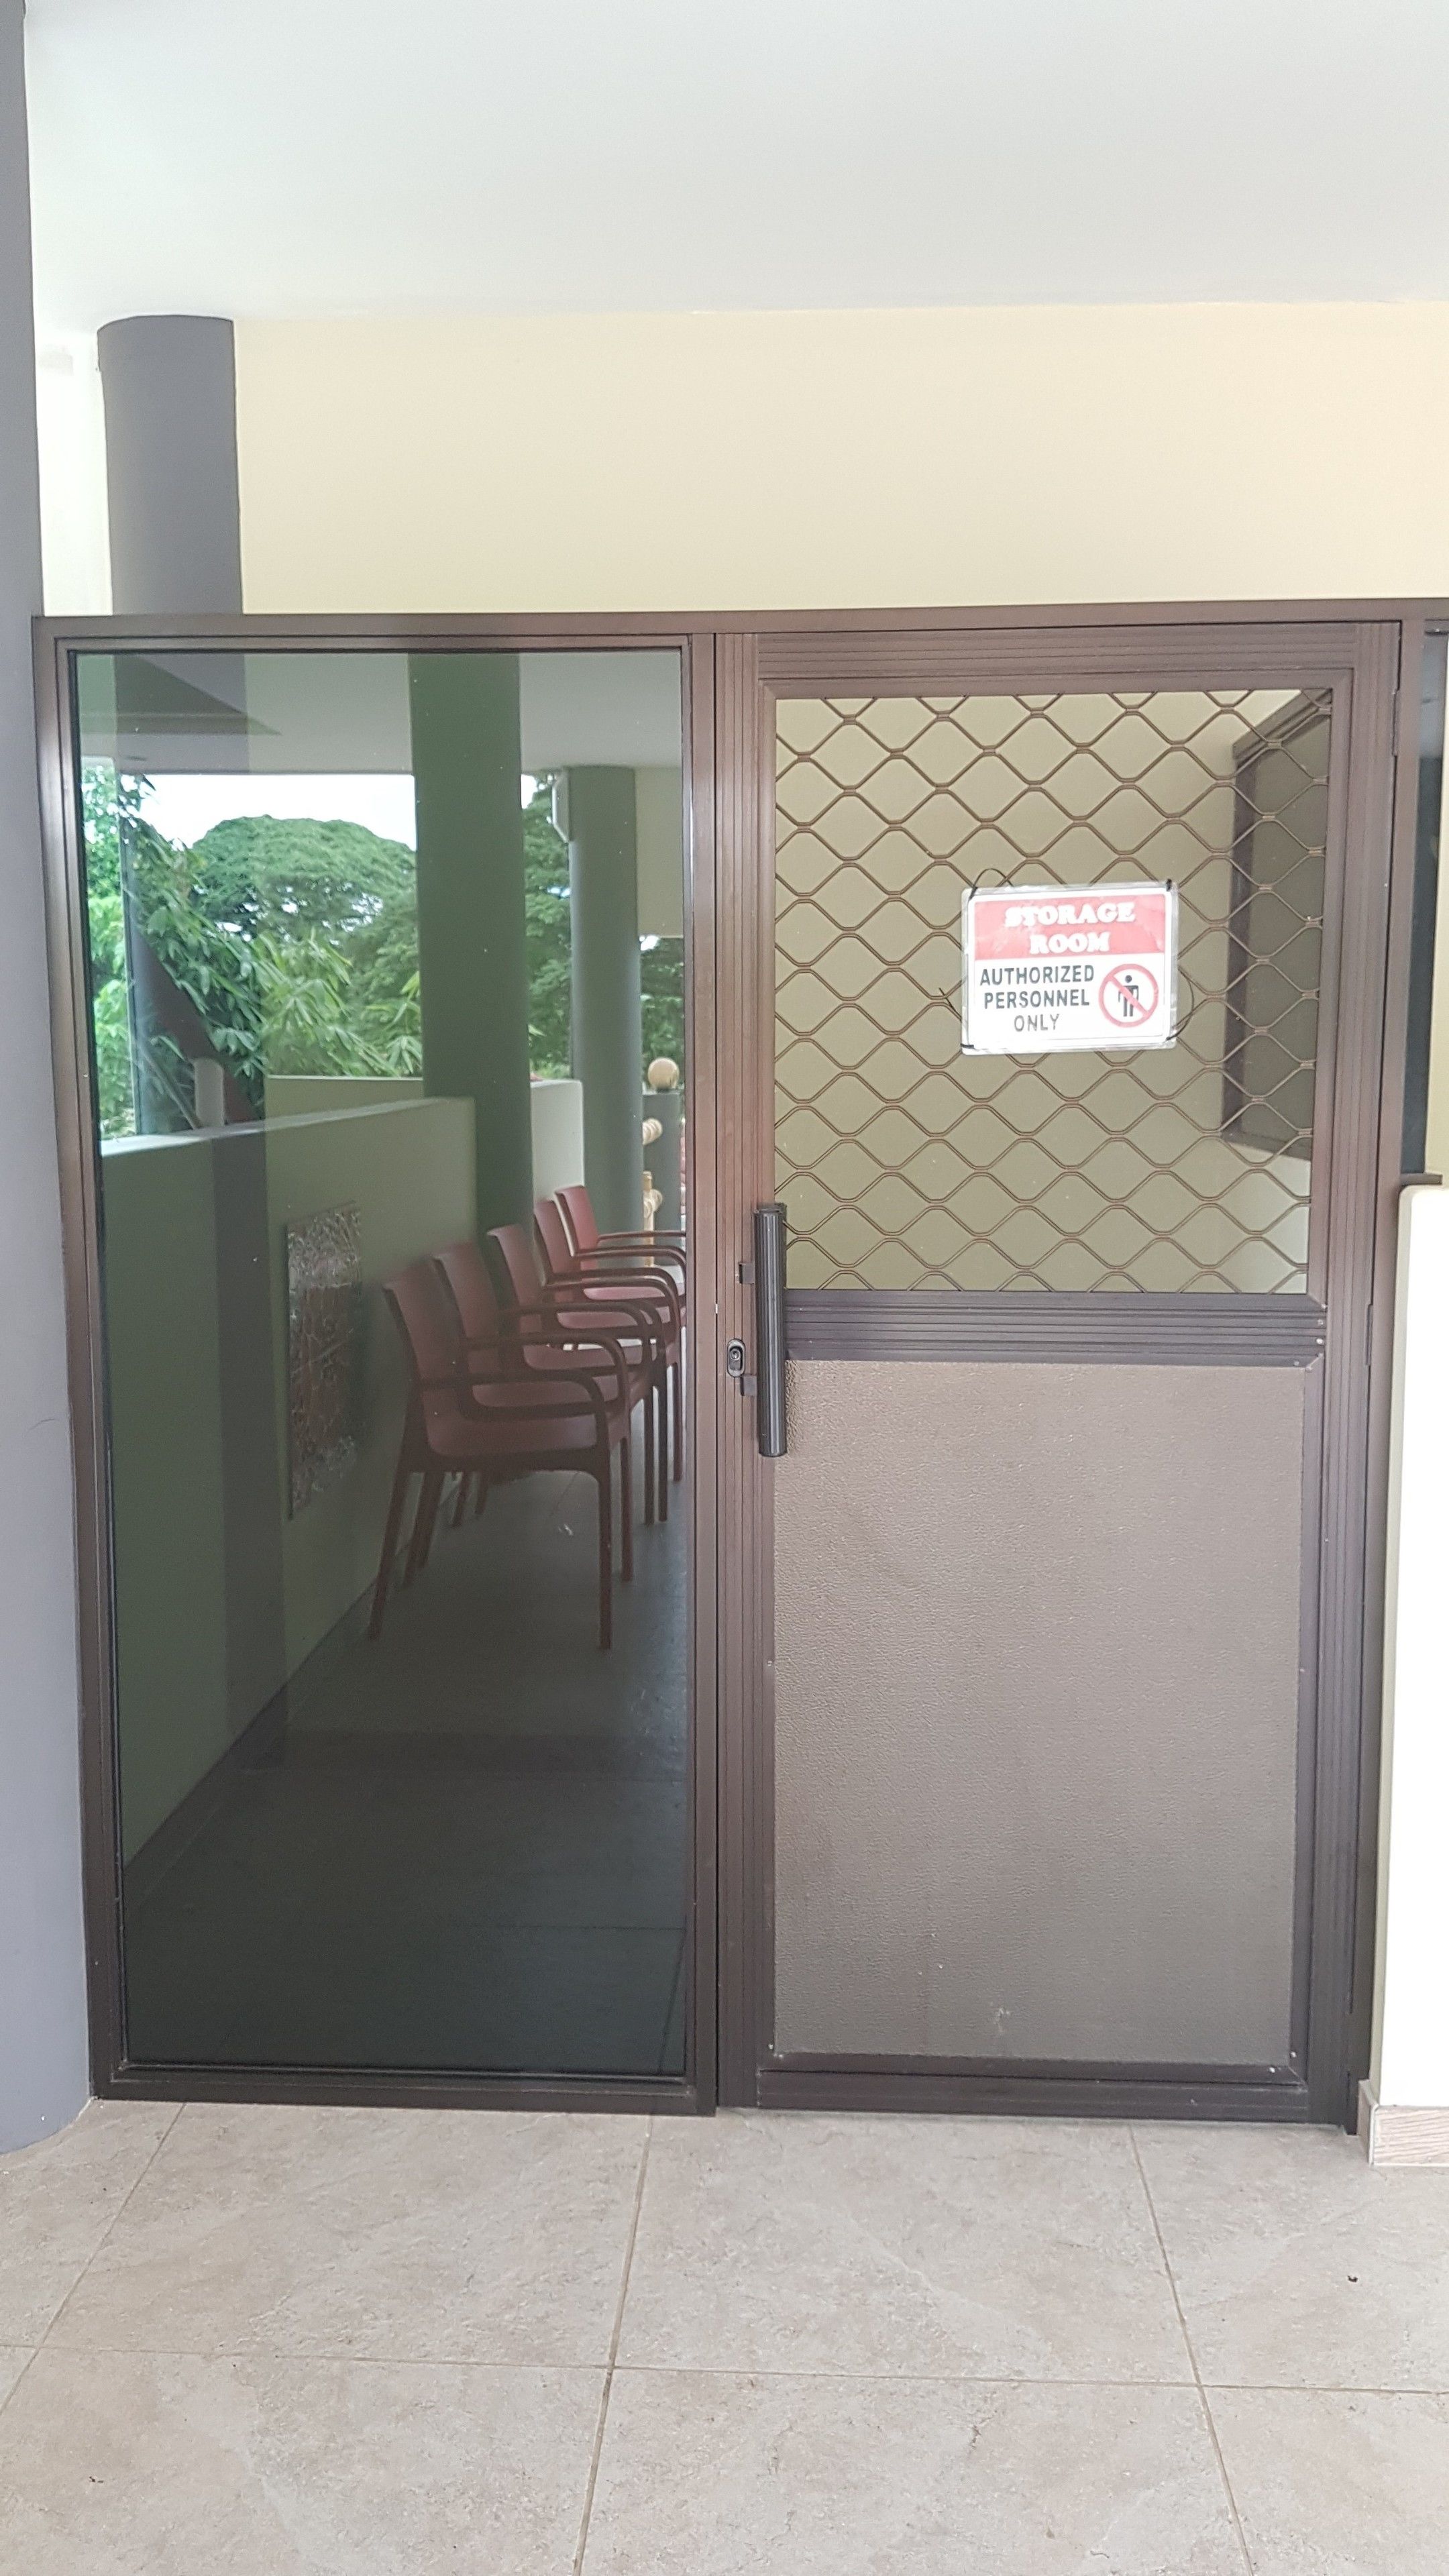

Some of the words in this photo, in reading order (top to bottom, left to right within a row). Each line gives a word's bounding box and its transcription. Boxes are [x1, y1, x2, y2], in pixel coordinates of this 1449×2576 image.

[1004, 902, 1136, 927] STORAGE
[1029, 932, 1111, 955] ROOM
[979, 964, 1095, 986] AUTHORIZED
[984, 989, 1090, 1009] PERSONNEL
[1014, 1014, 1060, 1032] ONLY
